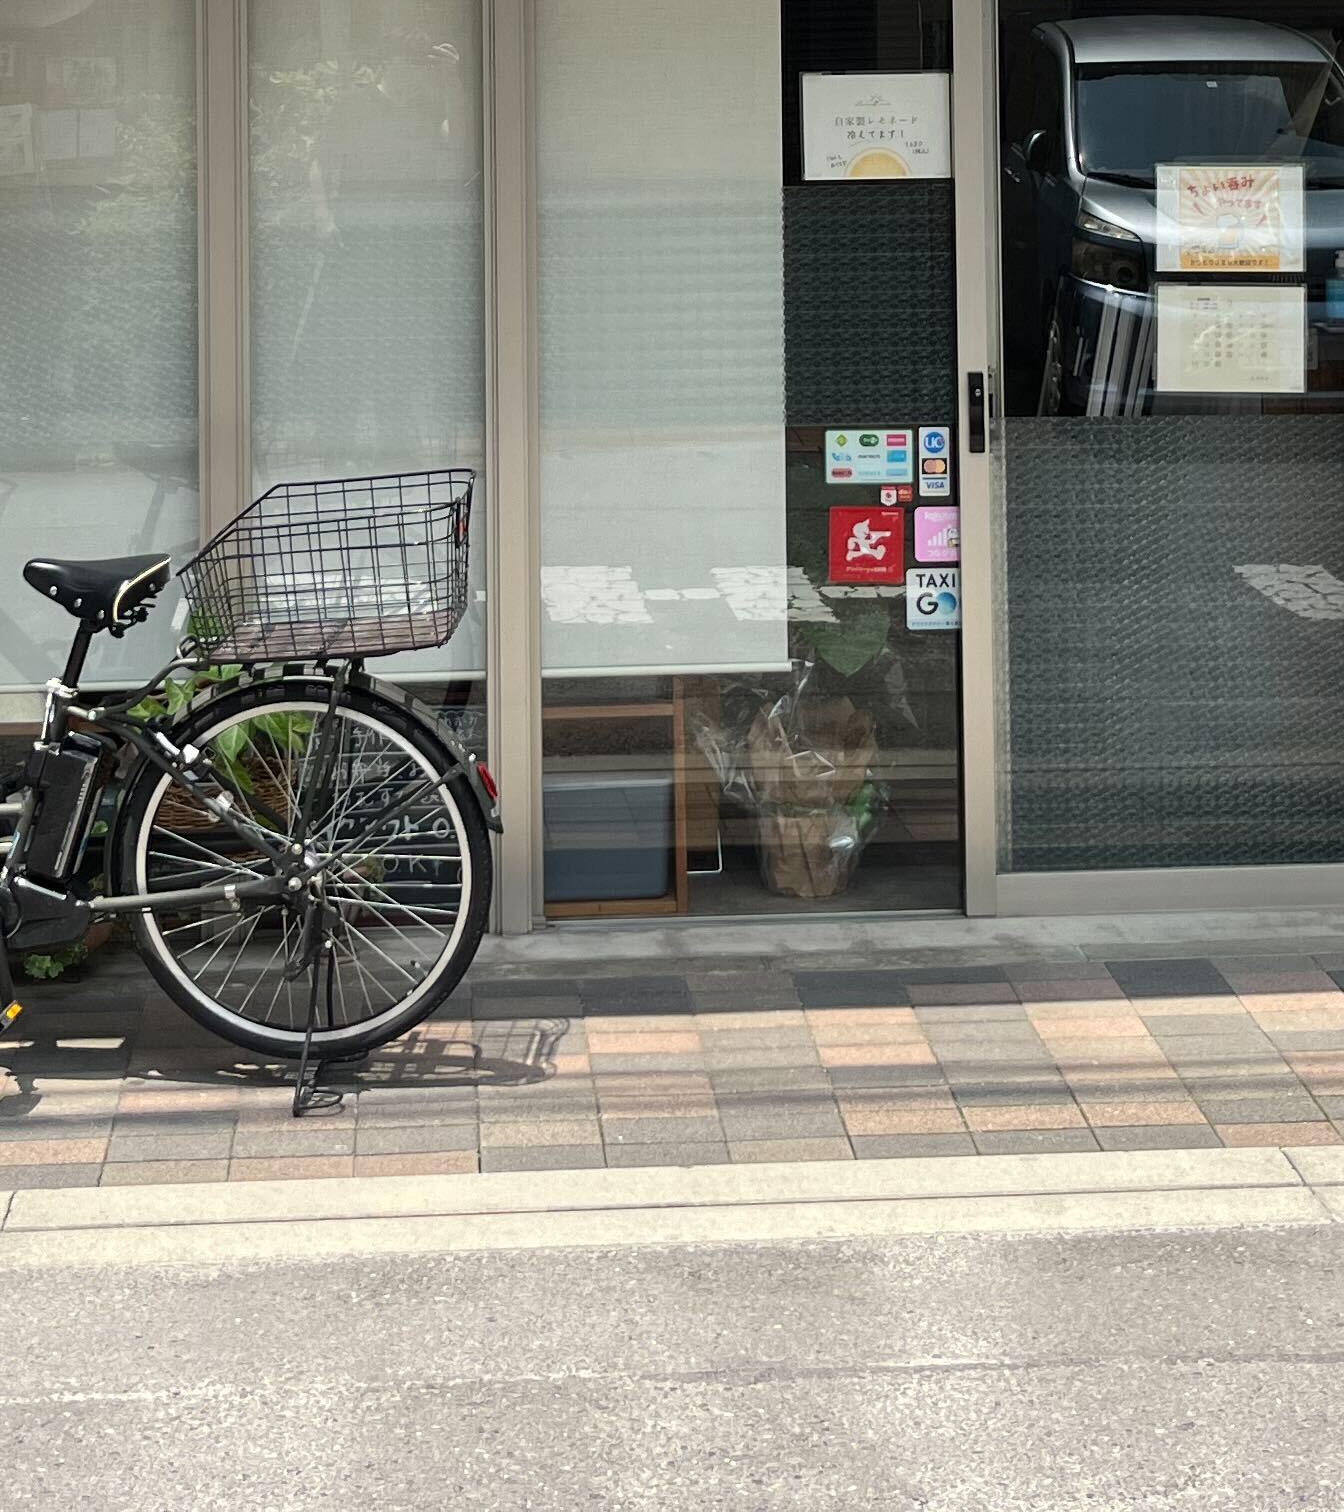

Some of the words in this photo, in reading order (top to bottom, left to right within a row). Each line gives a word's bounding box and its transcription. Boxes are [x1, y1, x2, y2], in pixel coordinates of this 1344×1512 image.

[925, 481, 945, 489] VISA
[915, 572, 956, 588] TAXI
[916, 591, 958, 615] GO
